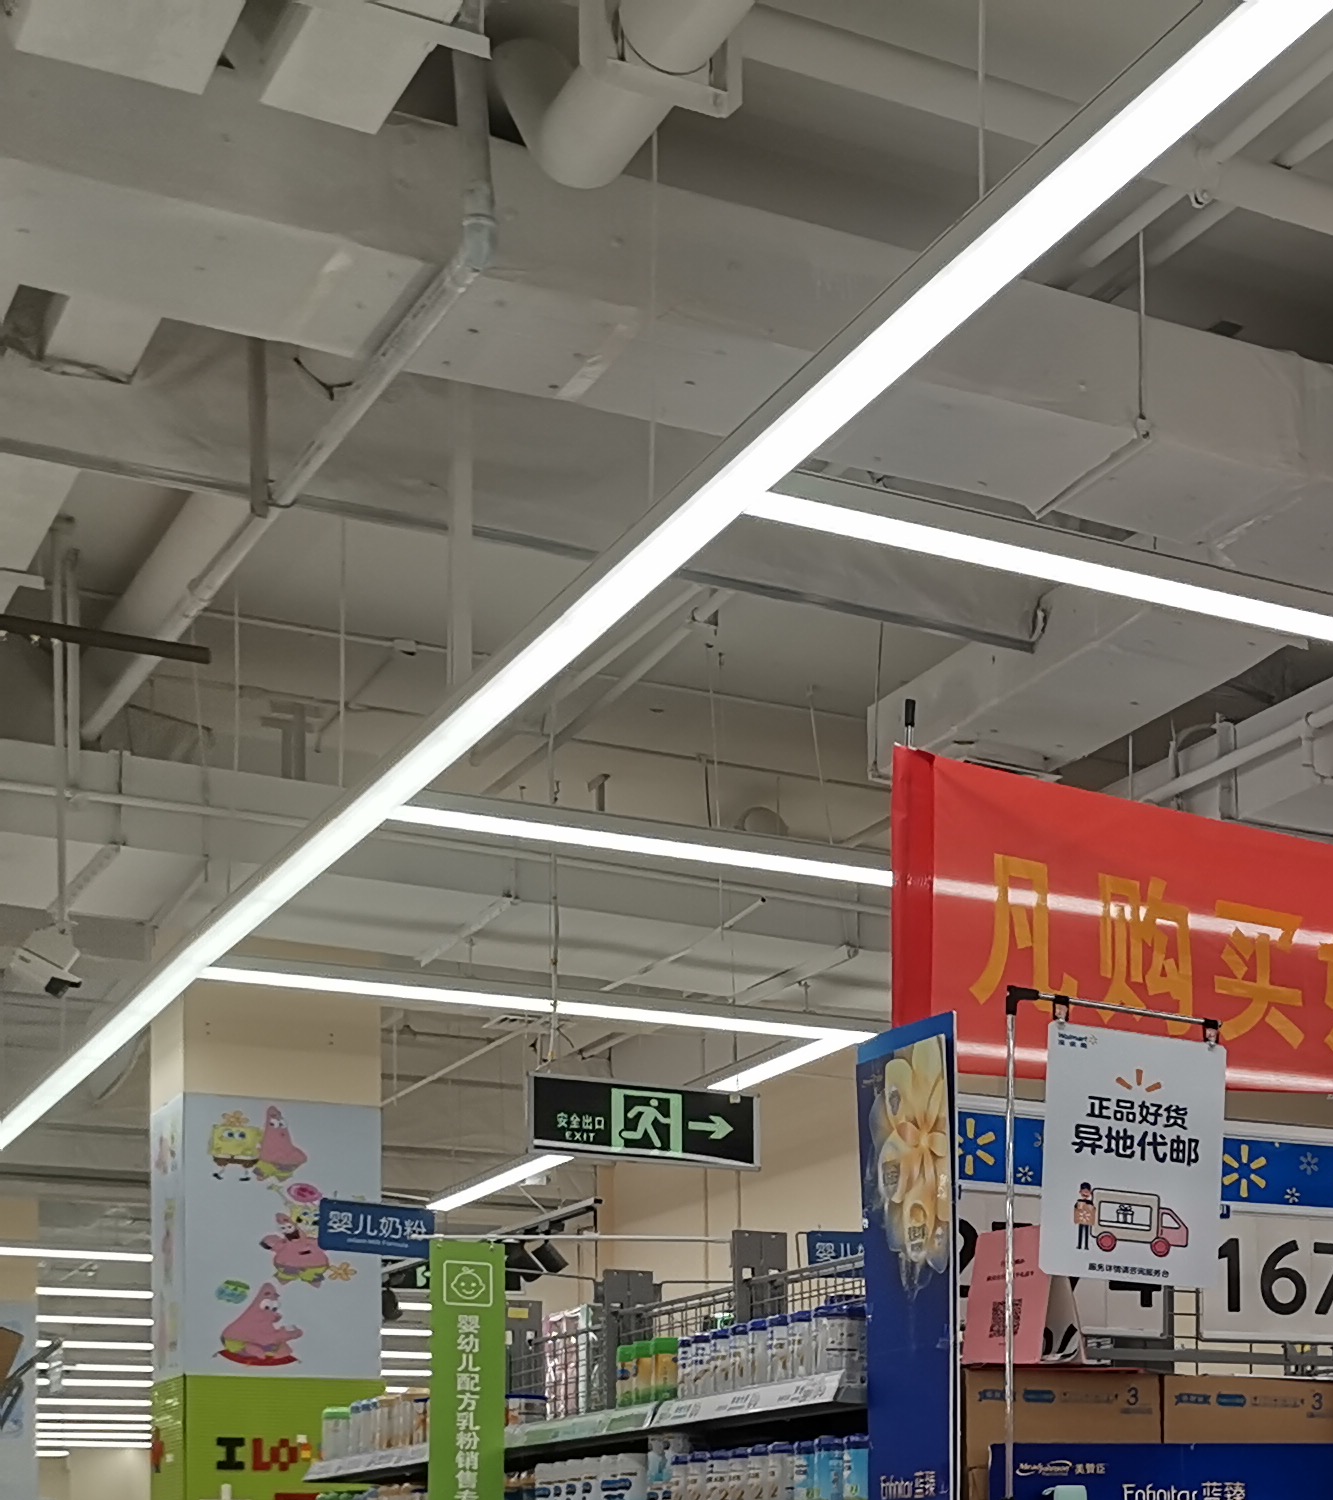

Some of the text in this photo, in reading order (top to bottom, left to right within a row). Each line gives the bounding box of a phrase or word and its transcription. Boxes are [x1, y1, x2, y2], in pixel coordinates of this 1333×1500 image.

[556, 1112, 606, 1131] 安全出口
[1086, 1094, 1189, 1131] 正品好货
[564, 1131, 596, 1143] EXIT
[1071, 1123, 1200, 1167] 异地代邮
[1126, 1386, 1139, 1407] 3
[1311, 1392, 1323, 1411] 3
